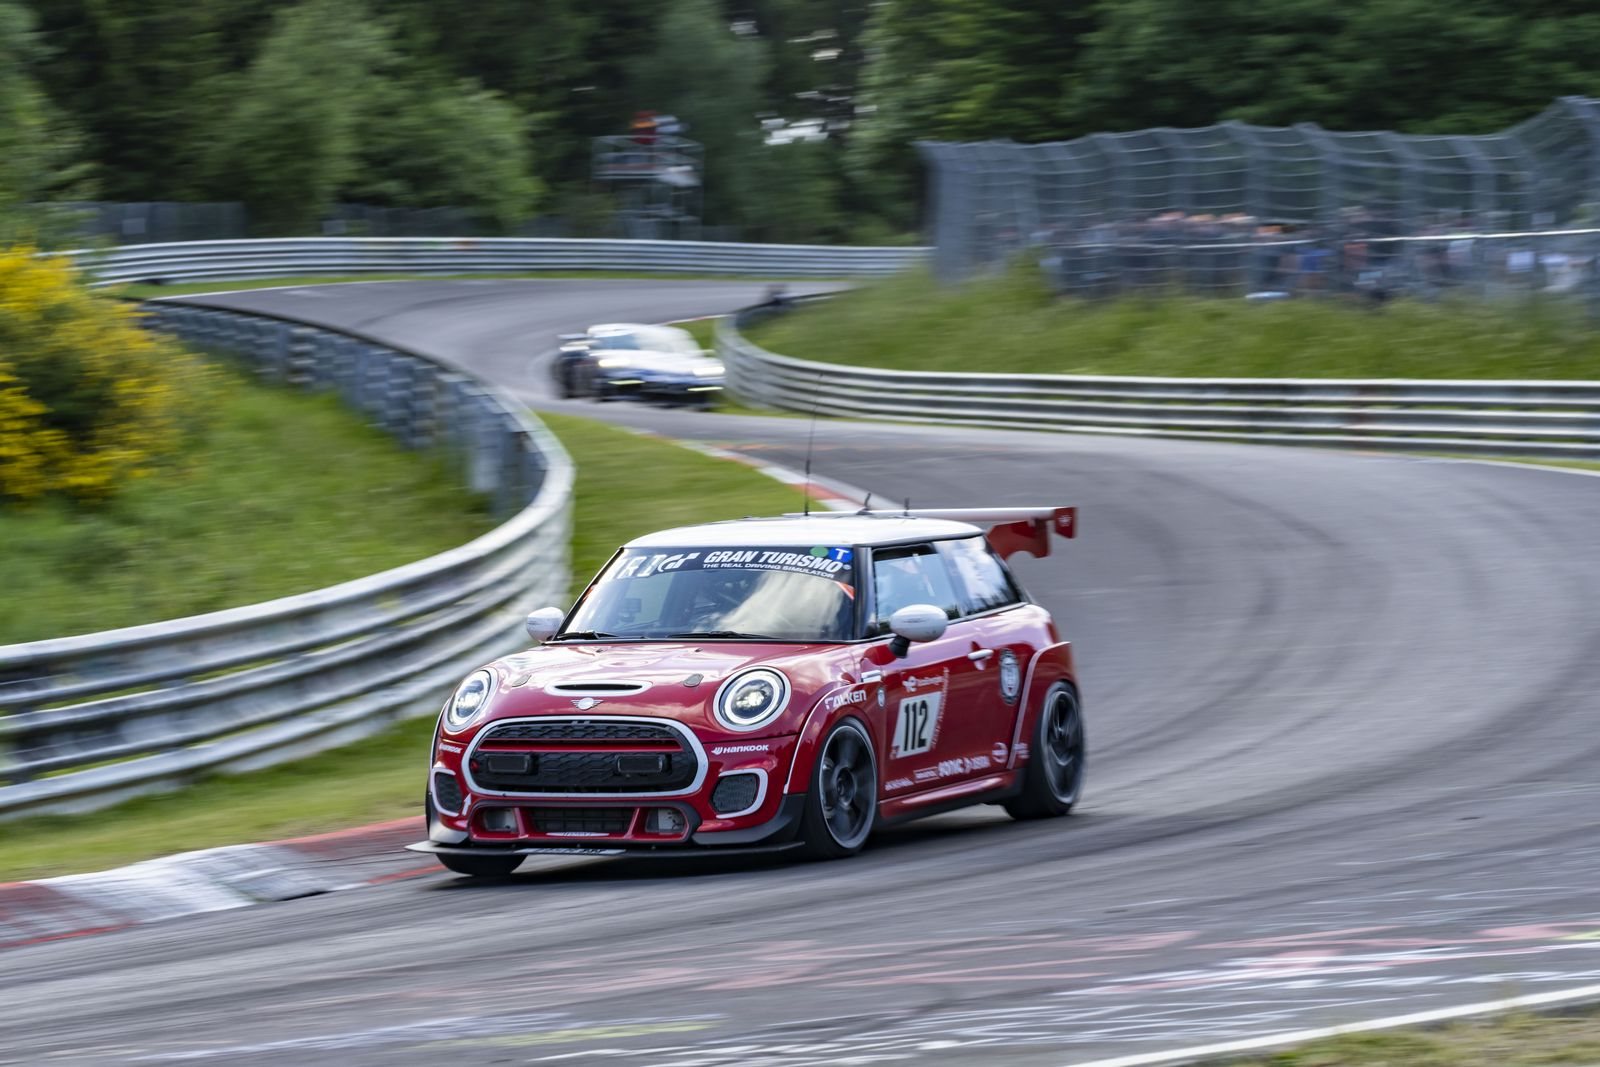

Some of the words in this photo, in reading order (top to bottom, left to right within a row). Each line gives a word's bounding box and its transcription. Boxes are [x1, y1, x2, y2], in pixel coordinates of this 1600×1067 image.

[703, 550, 759, 564] GRAN
[835, 548, 849, 560] T
[782, 565, 835, 579] SIMULATOR
[903, 700, 928, 752] 112
